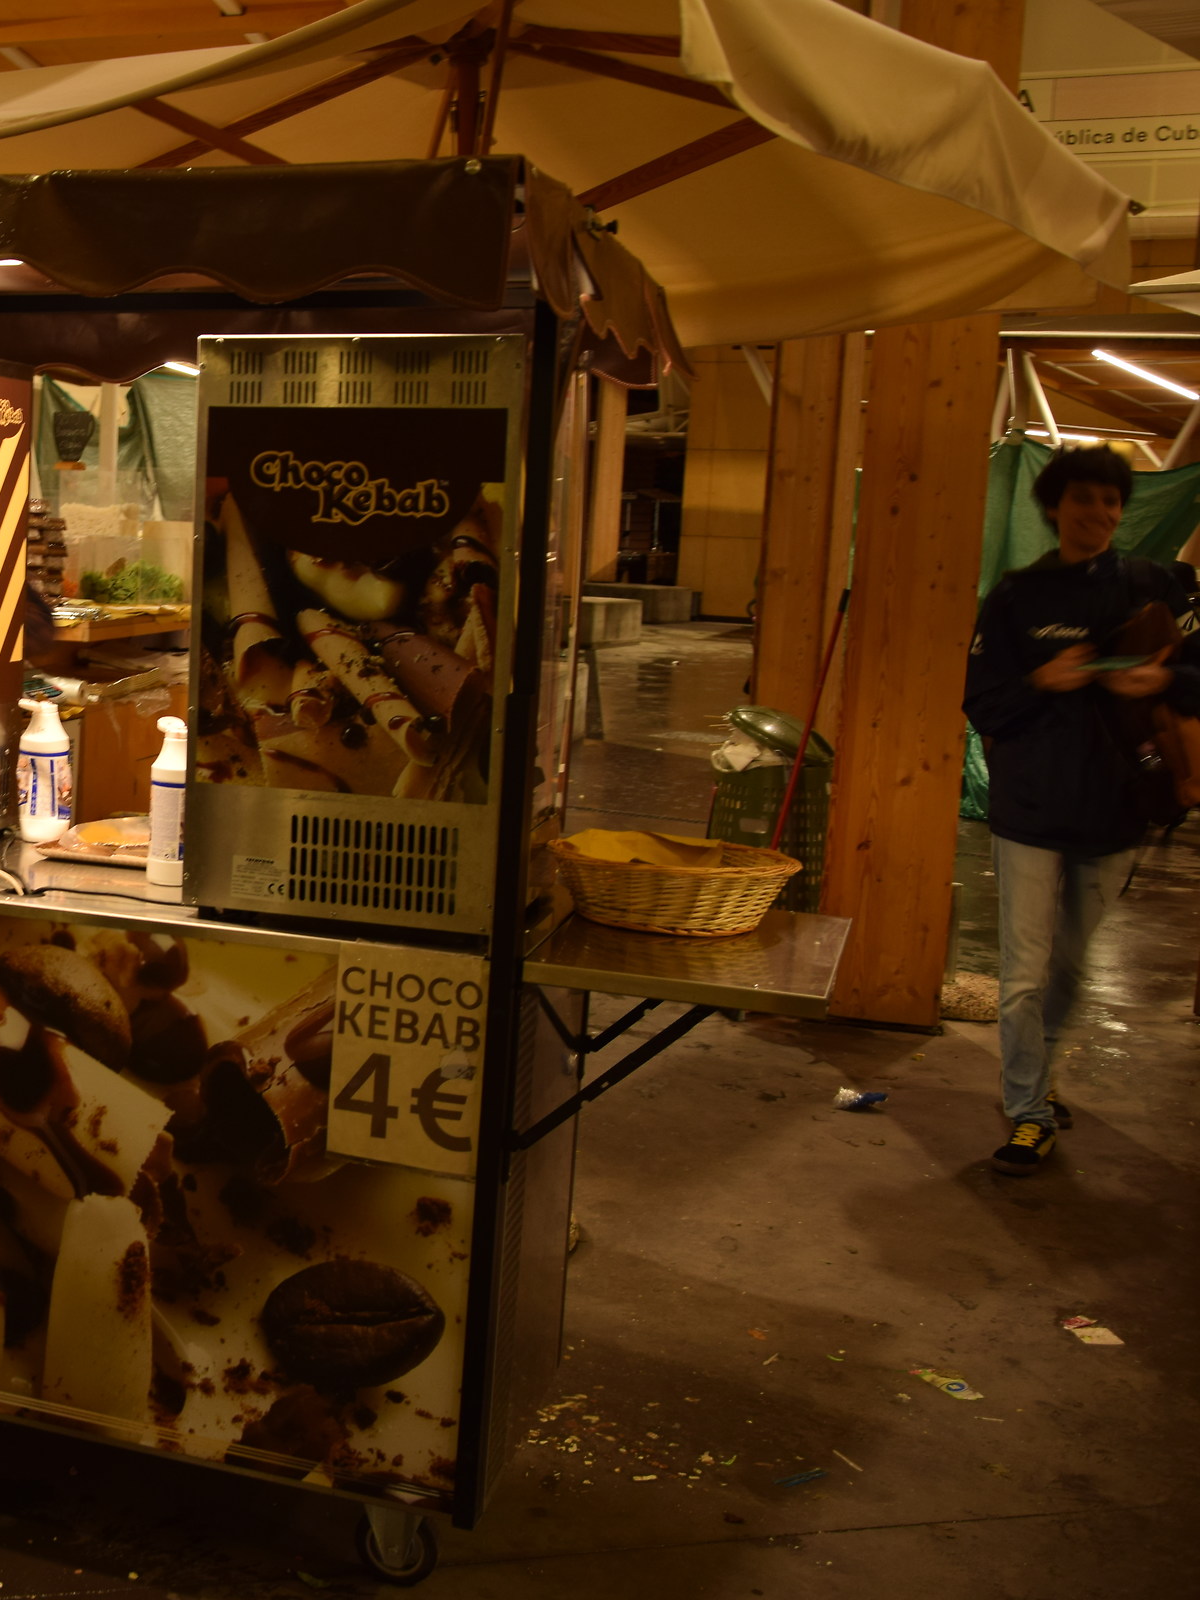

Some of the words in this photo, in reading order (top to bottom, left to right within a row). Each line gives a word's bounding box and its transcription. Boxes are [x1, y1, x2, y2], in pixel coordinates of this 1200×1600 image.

[1122, 127, 1147, 144] de
[250, 450, 369, 492] Choco
[310, 478, 450, 527] Kebab
[341, 966, 483, 1010] CHOCO
[337, 1001, 481, 1052] KEBAB
